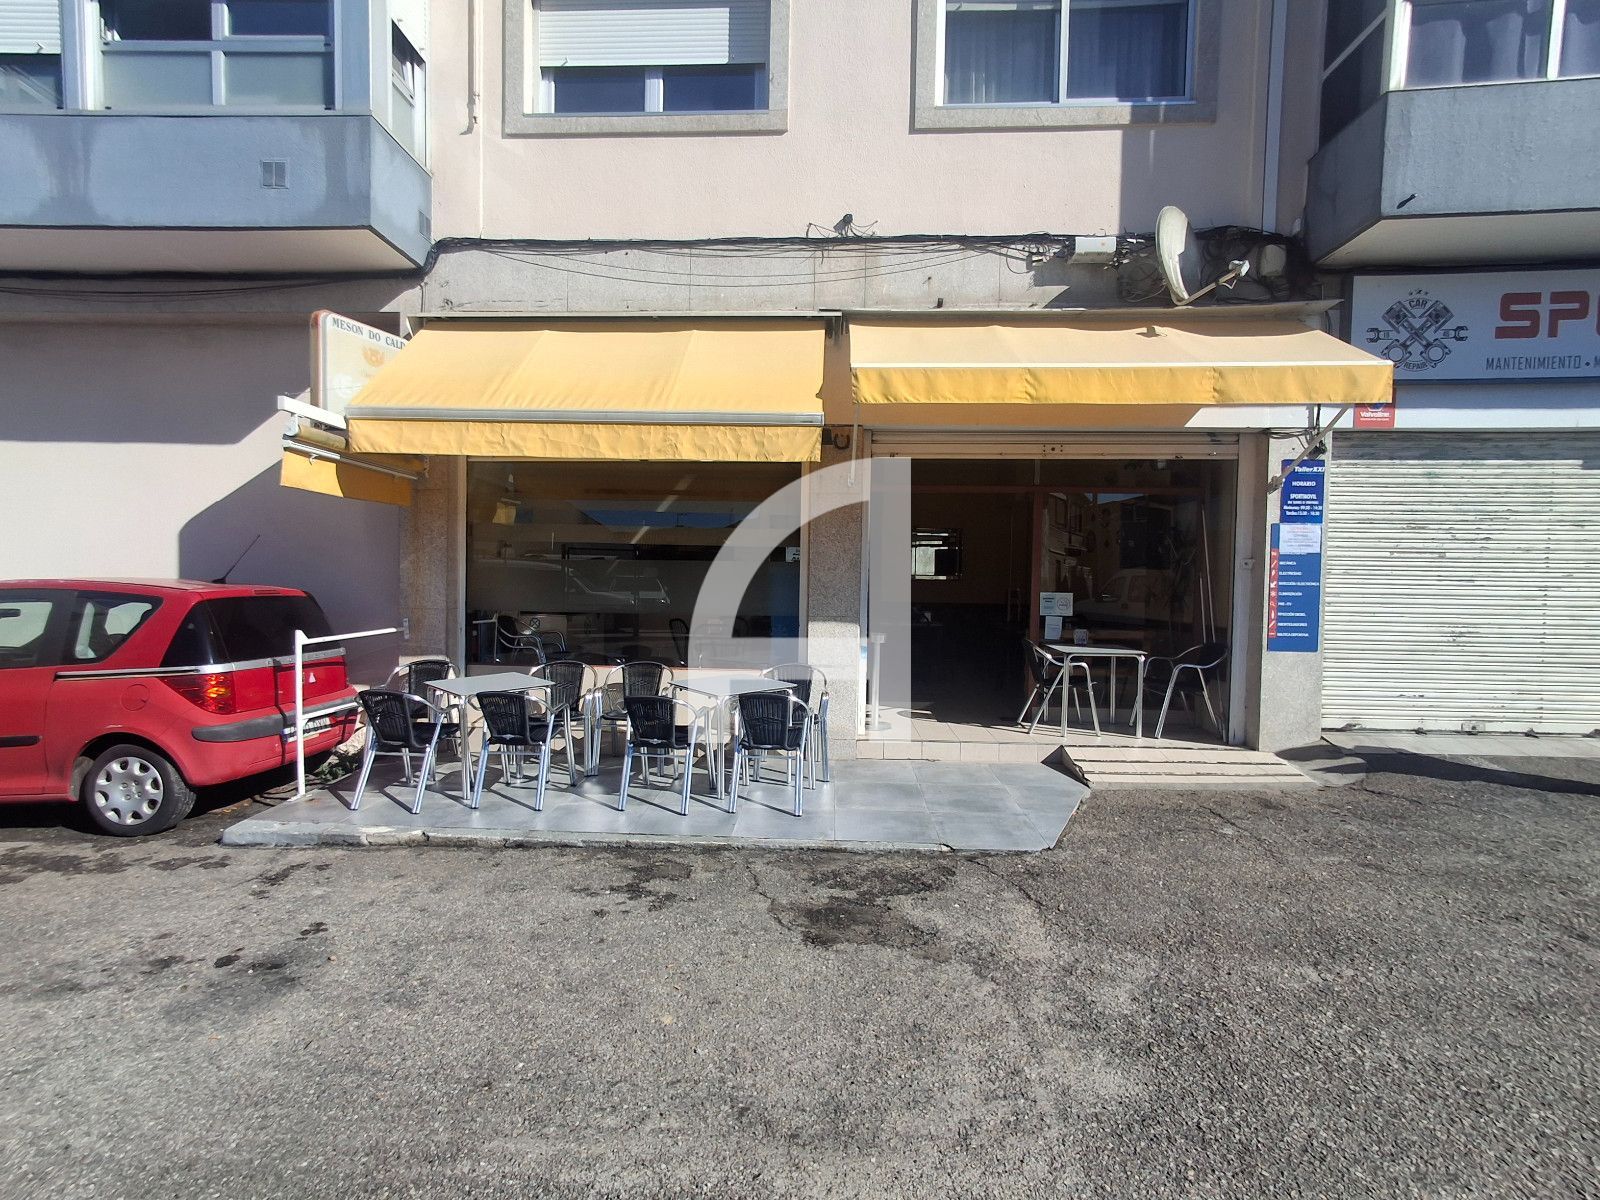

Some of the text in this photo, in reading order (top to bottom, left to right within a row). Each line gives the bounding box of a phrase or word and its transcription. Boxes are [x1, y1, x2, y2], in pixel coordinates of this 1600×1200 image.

[1408, 299, 1428, 309] CAR
[1494, 290, 1600, 340] SP
[332, 317, 364, 336] MESON
[368, 329, 381, 342] DO
[1404, 361, 1428, 370] REPAIR
[1485, 355, 1582, 371] MANTENIMIENTO
